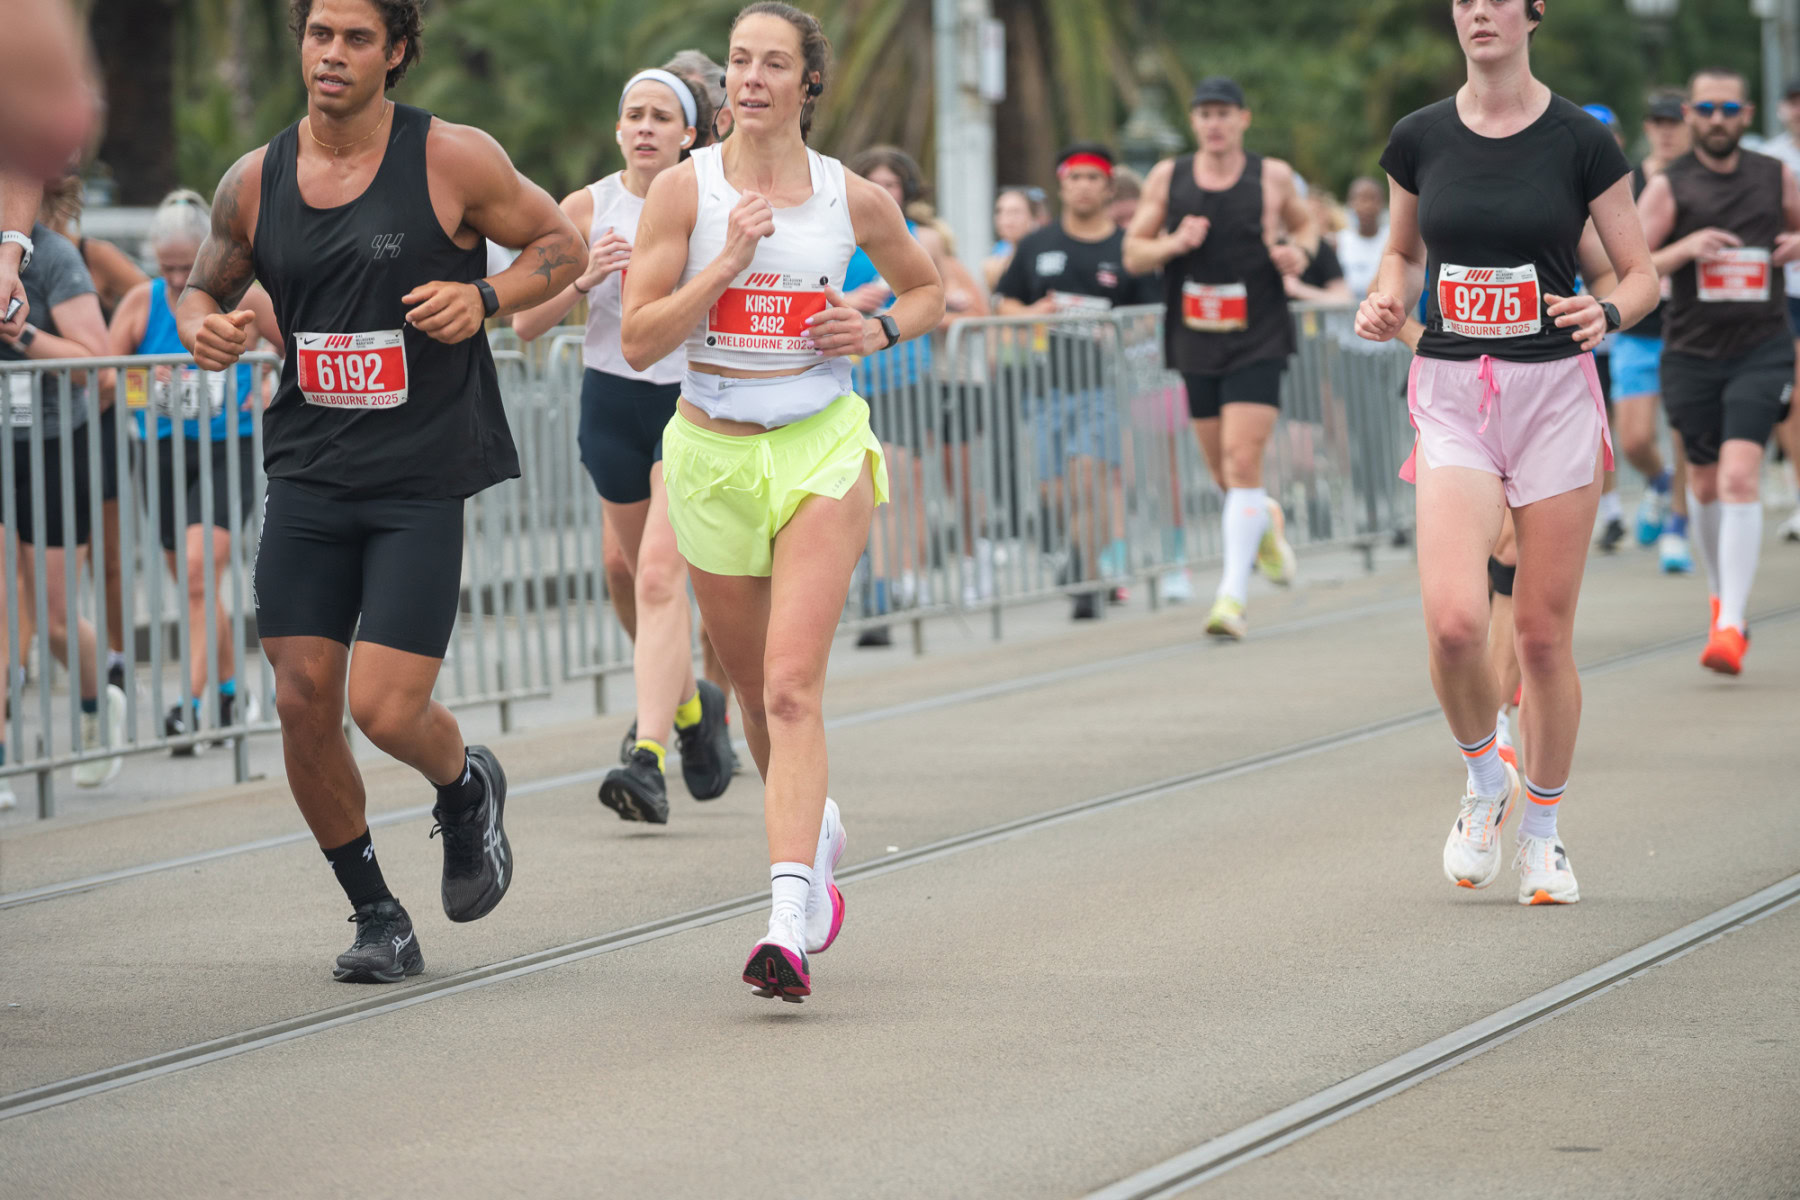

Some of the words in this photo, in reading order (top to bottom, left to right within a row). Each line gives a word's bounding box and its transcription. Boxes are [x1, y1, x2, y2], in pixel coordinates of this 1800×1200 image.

[745, 294, 793, 314] KIRSTY
[1454, 286, 1521, 322] 9275
[750, 315, 785, 334] 3492
[1451, 322, 1502, 335] MELBOURNE
[1505, 323, 1530, 335] 2025
[717, 335, 783, 350] MELBOURNE
[316, 353, 385, 391] 6192
[311, 394, 369, 406] MELBOURNE
[370, 393, 399, 406] 2025
